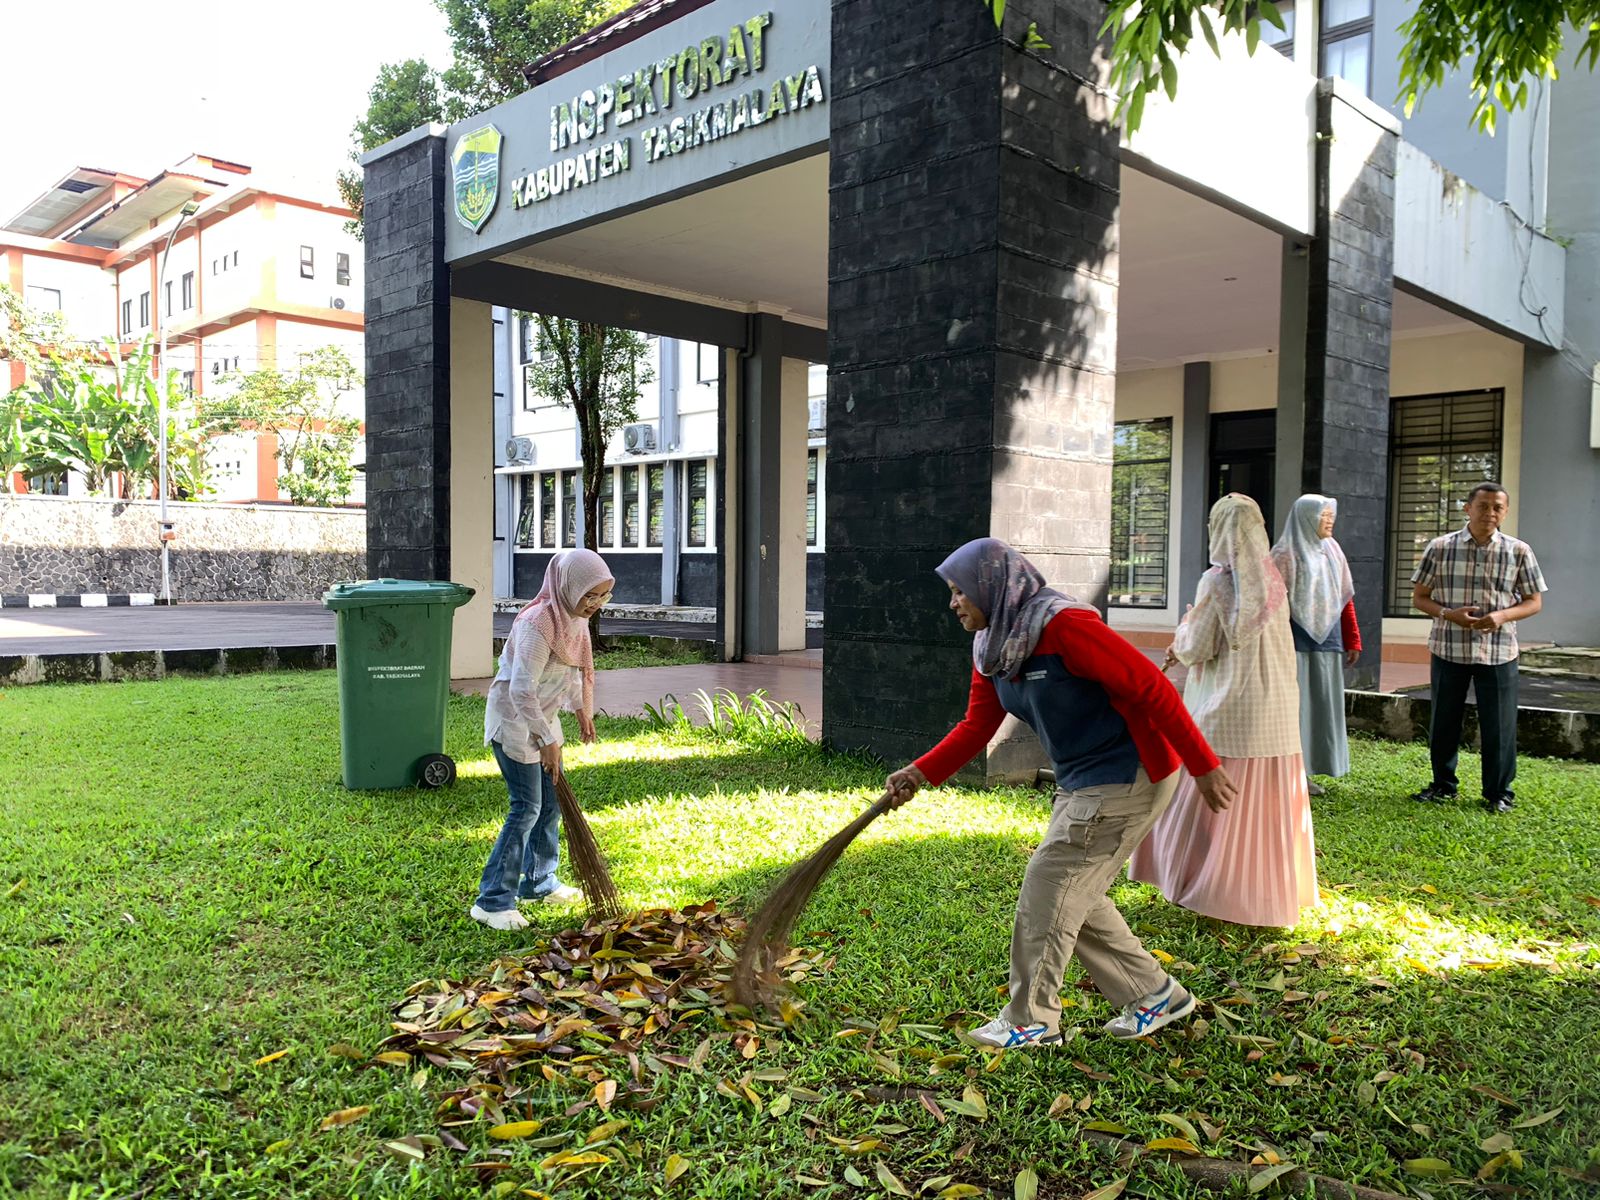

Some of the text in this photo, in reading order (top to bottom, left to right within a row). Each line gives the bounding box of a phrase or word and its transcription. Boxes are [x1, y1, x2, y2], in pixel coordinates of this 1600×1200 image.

[511, 65, 824, 210] KABUPATEN TASIKMALAYA
[549, 11, 773, 152] INSPEKTORAT
